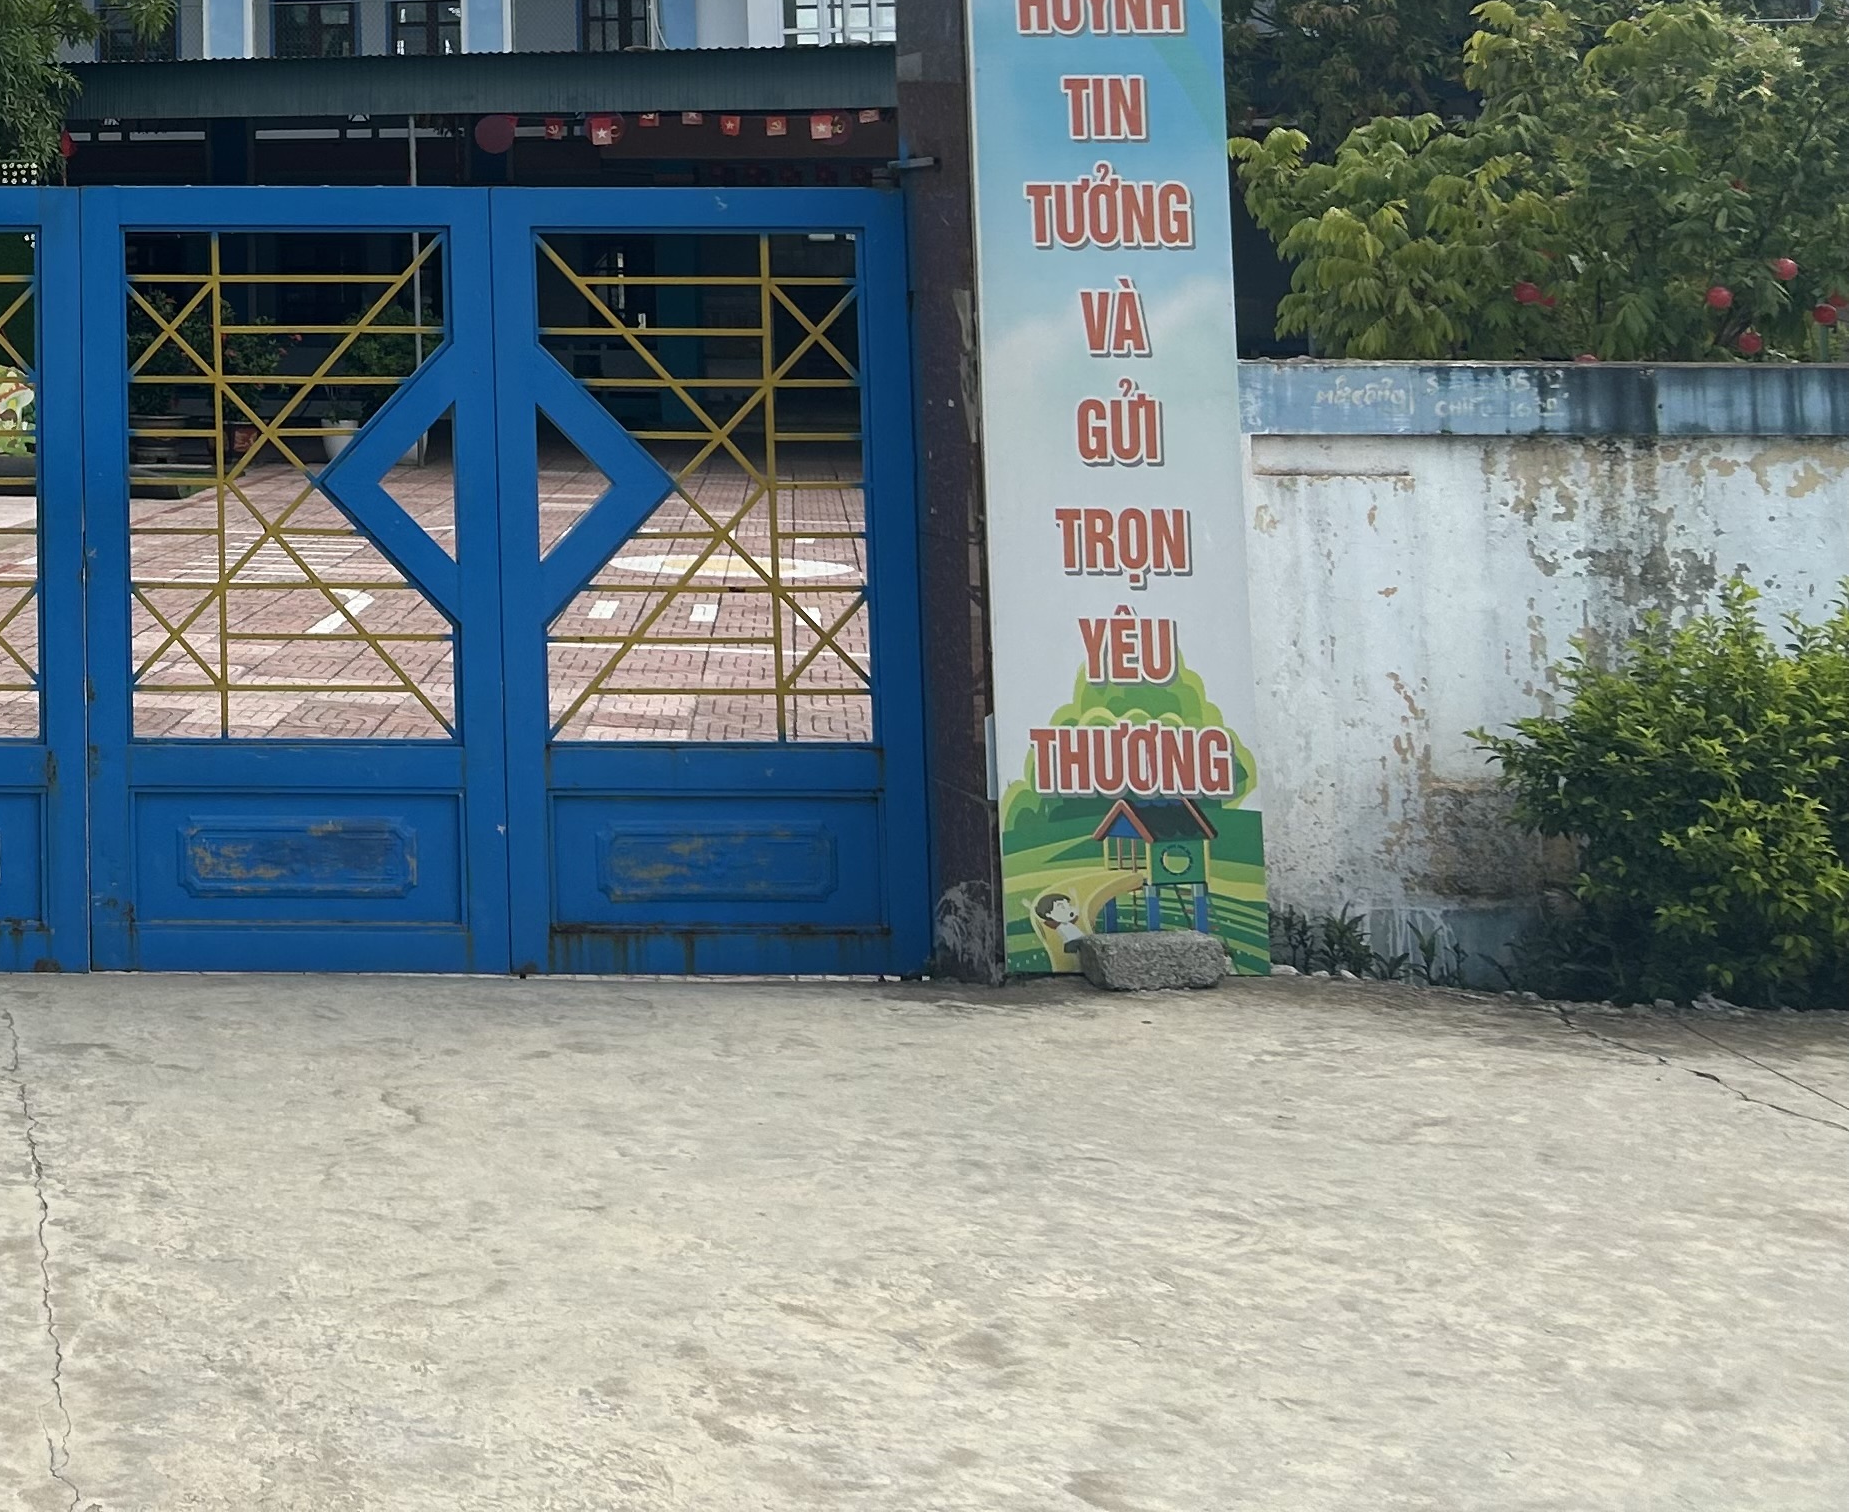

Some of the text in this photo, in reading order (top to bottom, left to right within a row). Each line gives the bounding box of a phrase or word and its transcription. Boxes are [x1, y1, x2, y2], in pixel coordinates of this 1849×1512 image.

[1064, 78, 1142, 136] TIN
[1027, 164, 1190, 244] TƯỞNG
[1081, 278, 1145, 350] VÀ
[1077, 378, 1158, 461] GỬI
[1055, 508, 1186, 582] TRỌN
[1079, 605, 1172, 679] YÊU
[1030, 724, 1229, 791] THƯƠNG
